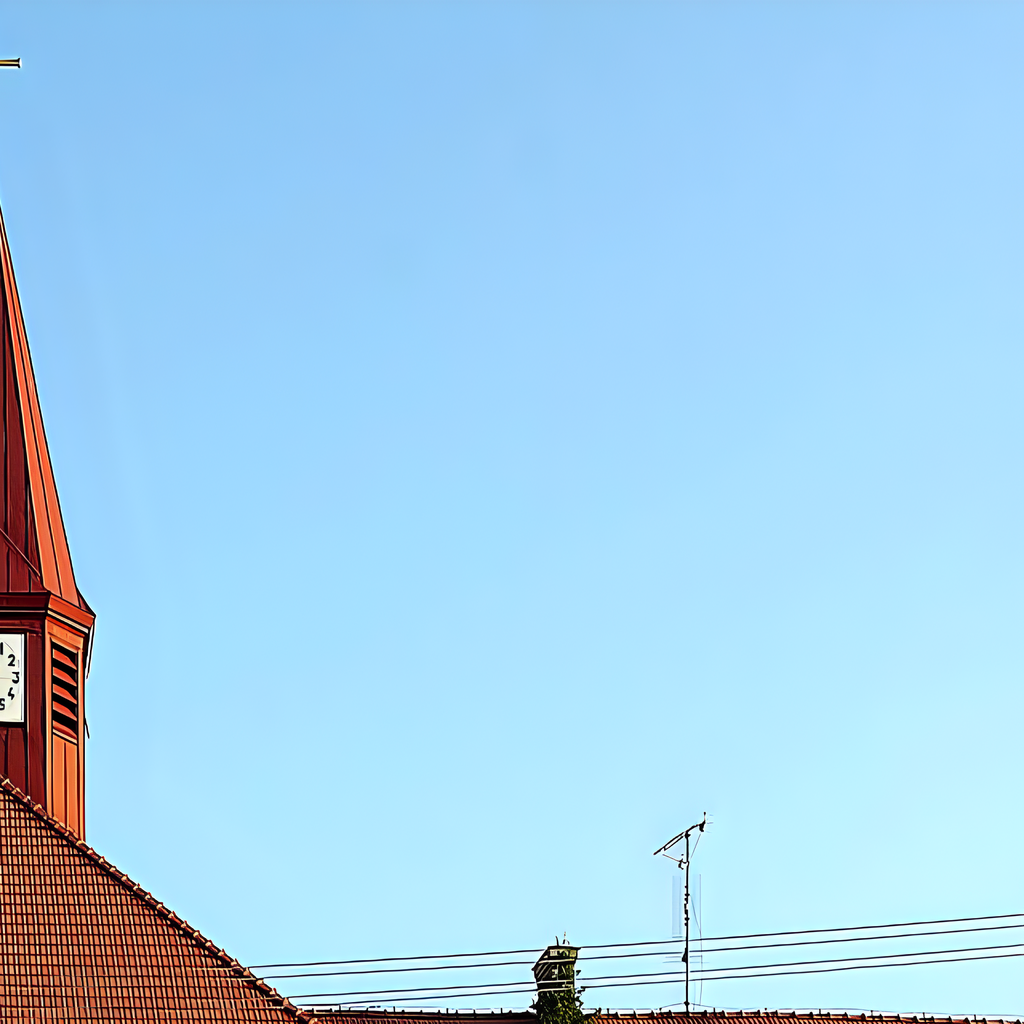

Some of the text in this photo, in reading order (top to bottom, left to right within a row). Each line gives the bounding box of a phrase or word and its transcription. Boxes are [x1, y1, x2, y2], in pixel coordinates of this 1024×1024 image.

[0, 642, 4, 655] 1
[7, 653, 16, 667] 2
[11, 671, 20, 684] 3
[7, 687, 15, 700] 4
